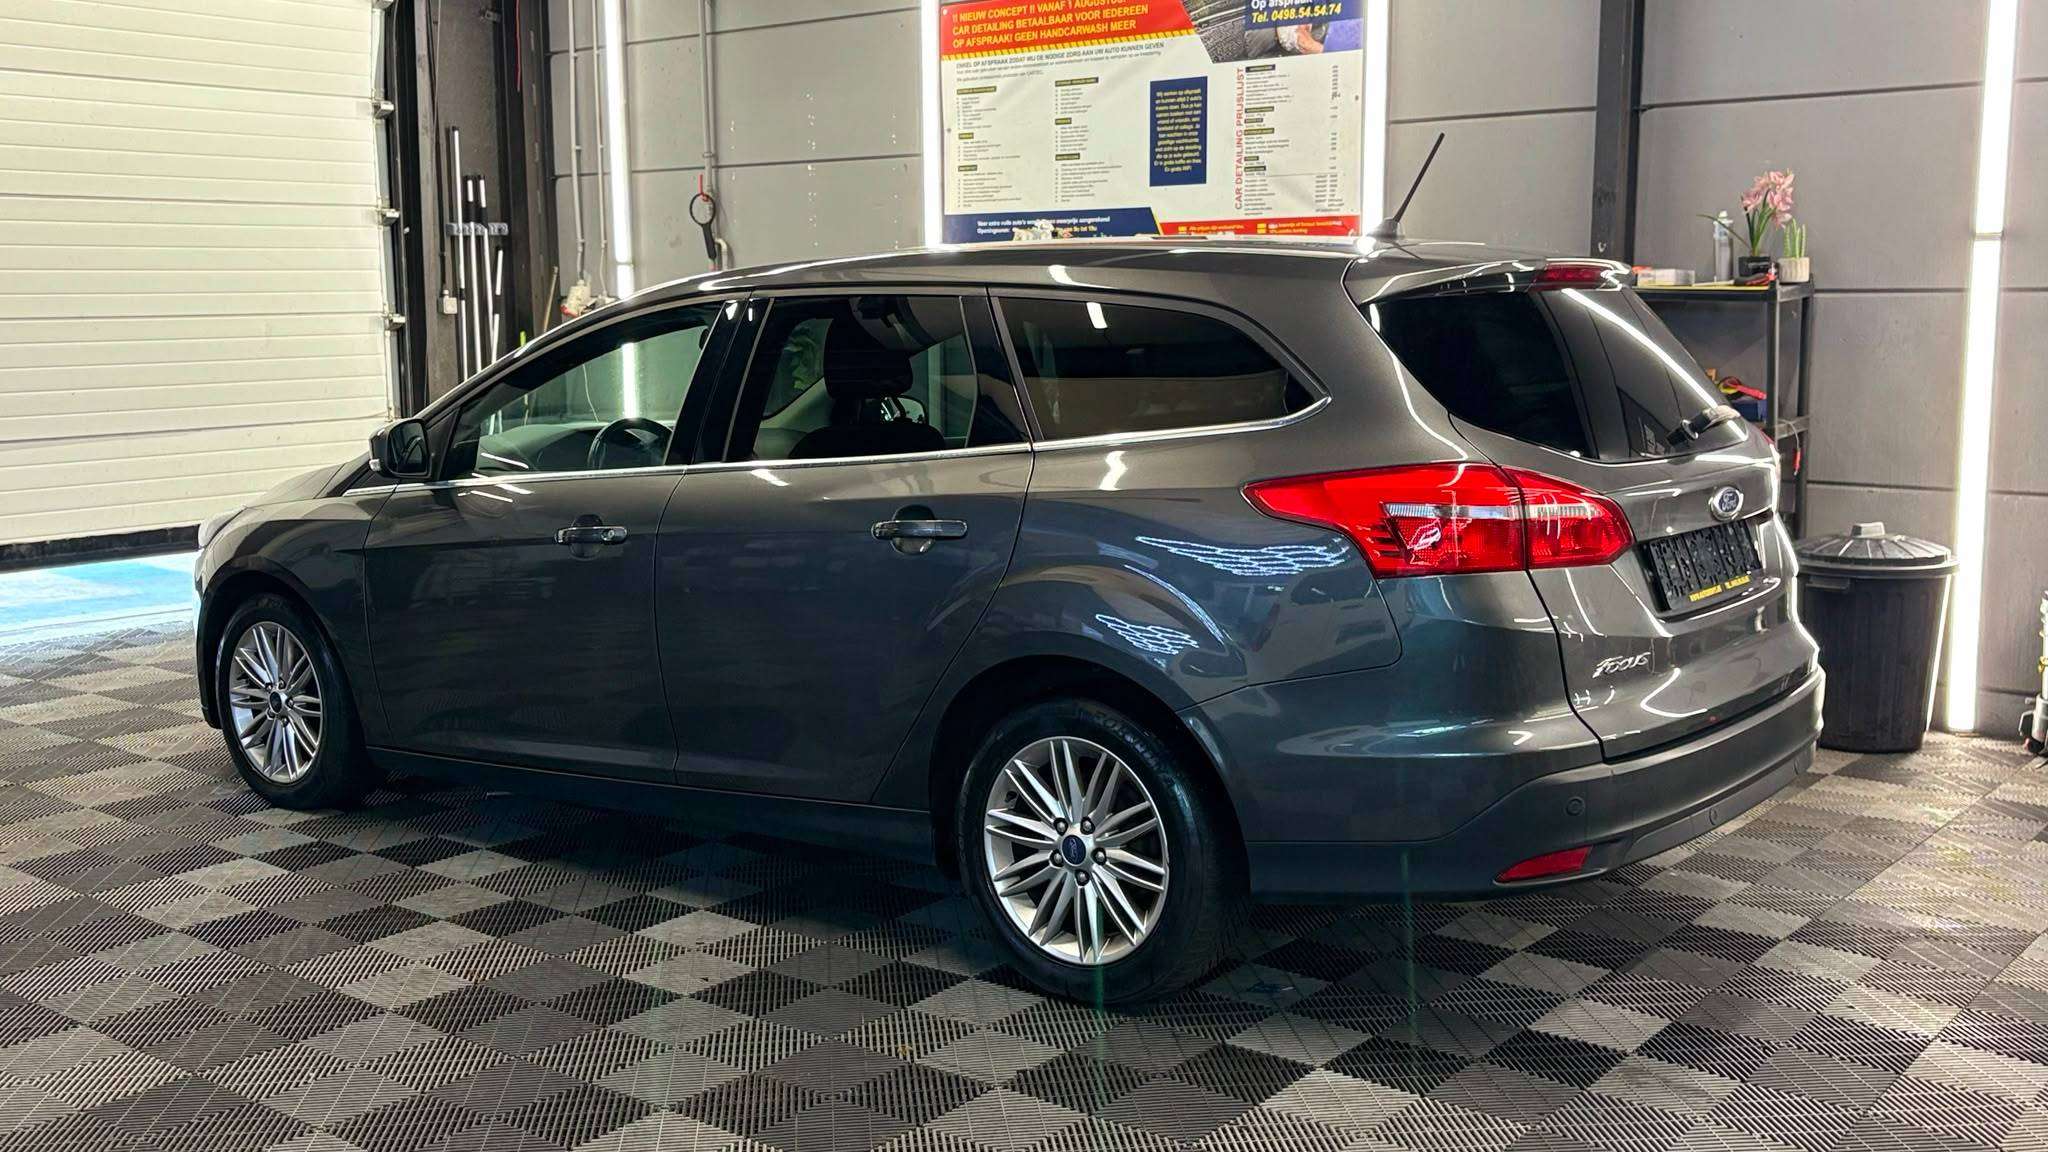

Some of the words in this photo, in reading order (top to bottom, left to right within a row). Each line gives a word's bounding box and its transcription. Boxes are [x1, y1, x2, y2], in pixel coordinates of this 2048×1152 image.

[959, 11, 987, 22] NIEUW
[987, 5, 1028, 19] CONCEPT
[1037, 0, 1066, 12] VANAF
[1074, 0, 1126, 9] AUGUS
[1251, 0, 1266, 11] Op
[1268, 0, 1312, 8] afspraa
[1251, 12, 1269, 23] Tel.
[1271, 3, 1341, 21] 0498.54.54.74
[952, 25, 970, 36] CAR
[971, 20, 1014, 34] DETAILING
[1016, 14, 1073, 29] BETAALBAAR
[1075, 10, 1101, 22] VOOR
[1102, 4, 1149, 19] IEDEREEN
[952, 38, 965, 48] OP
[1014, 30, 1039, 41] GEEN
[1040, 22, 1109, 39] HANDCARWASH
[1110, 19, 1137, 32] MEER
[981, 58, 1009, 66] AFSPRAAK
[1082, 48, 1094, 56] AAN
[1105, 46, 1120, 54] AUTO
[1236, 67, 1245, 129] PRIJSLIJST
[1235, 131, 1244, 184] DETAILING
[1235, 187, 1243, 210] CAR
[1721, 492, 1738, 511] Ford
[1592, 651, 1652, 679] Focus
